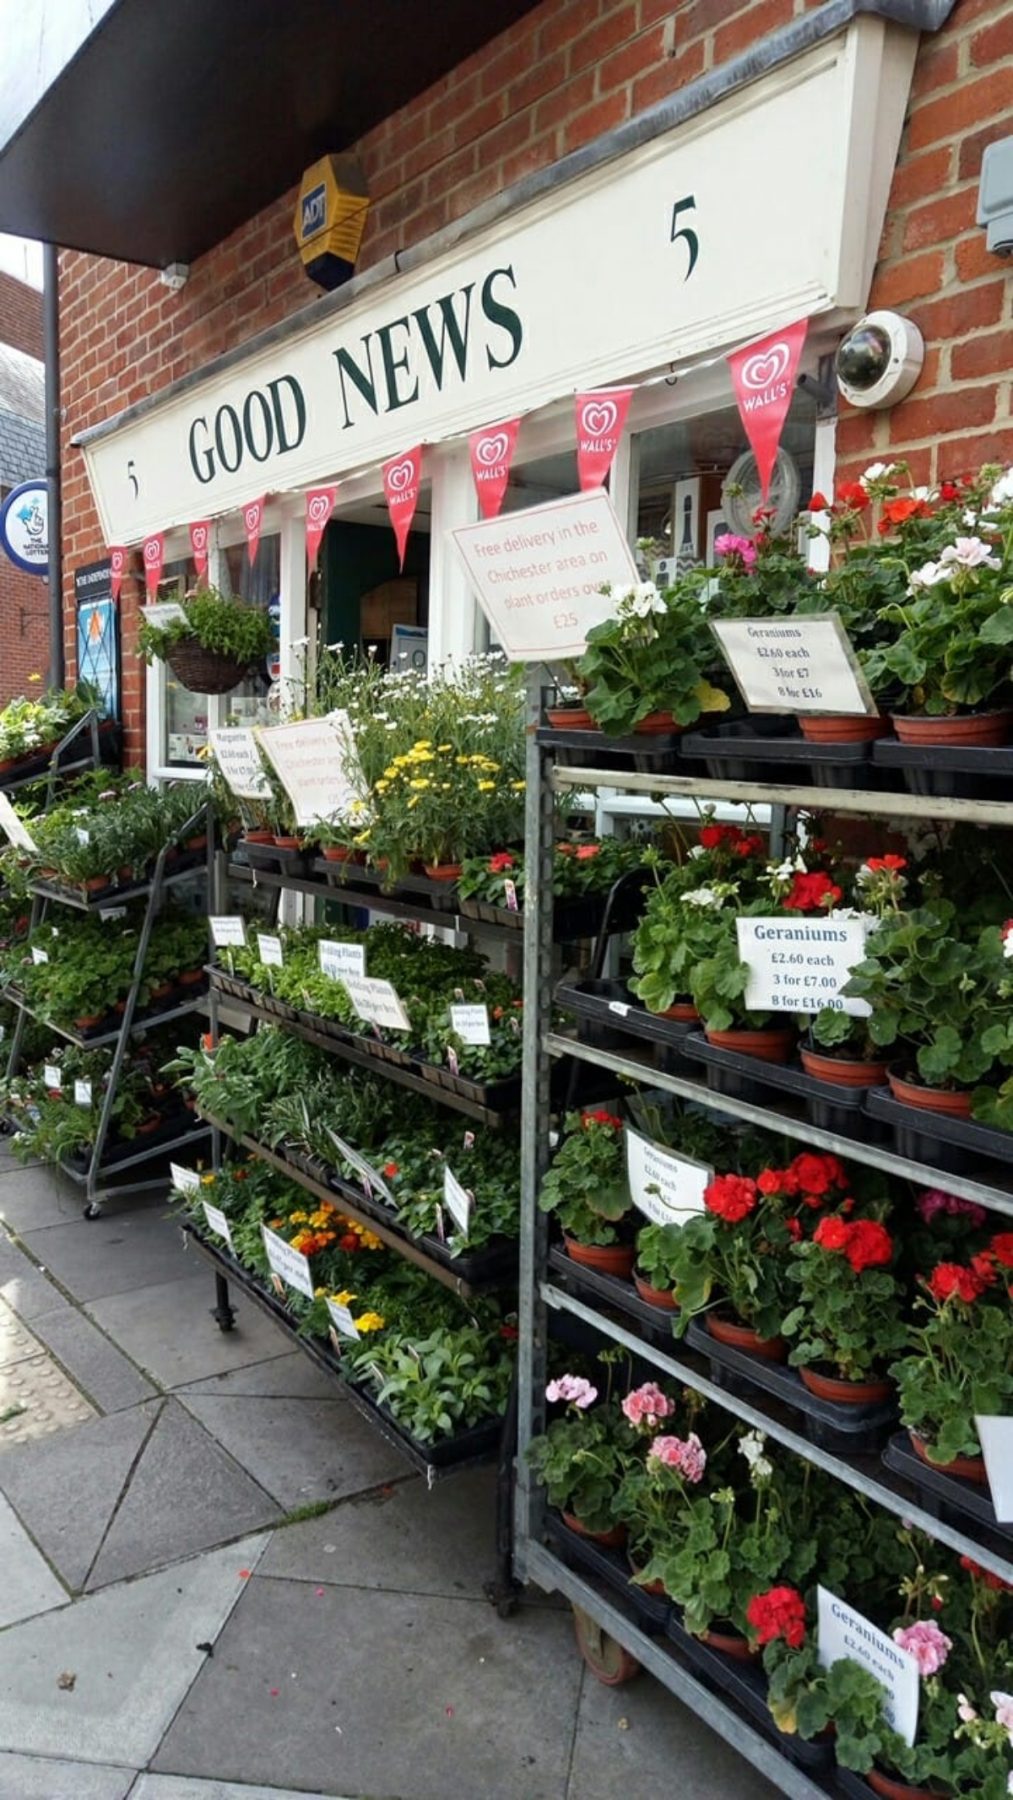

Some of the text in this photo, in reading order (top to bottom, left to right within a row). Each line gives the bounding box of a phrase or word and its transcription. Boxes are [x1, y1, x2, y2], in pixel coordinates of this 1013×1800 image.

[303, 193, 325, 226] ADT
[127, 194, 699, 499] 5 GOOD NEWS 5
[742, 385, 788, 413] WALL'S
[580, 439, 613, 451] WALL'S
[475, 465, 507, 481] WALL'S
[388, 489, 416, 505] WALL'S
[474, 519, 600, 557] Free delivery in the
[487, 551, 609, 584] Chichester area on
[504, 592, 536, 609] plant
[536, 585, 580, 605] orders
[553, 612, 579, 630] £25
[747, 627, 802, 639] Geraniums
[784, 648, 810, 658] each
[797, 668, 810, 678] £7
[801, 688, 823, 698] £16
[754, 924, 848, 942] Geraniums
[771, 952, 835, 967] £2.60 each
[773, 974, 837, 989] 3 for £7.00
[781, 994, 800, 1007] for
[801, 996, 844, 1010] £1600
[831, 1603, 905, 1670] Geraniums
[843, 1634, 895, 1683] £2.60 each
